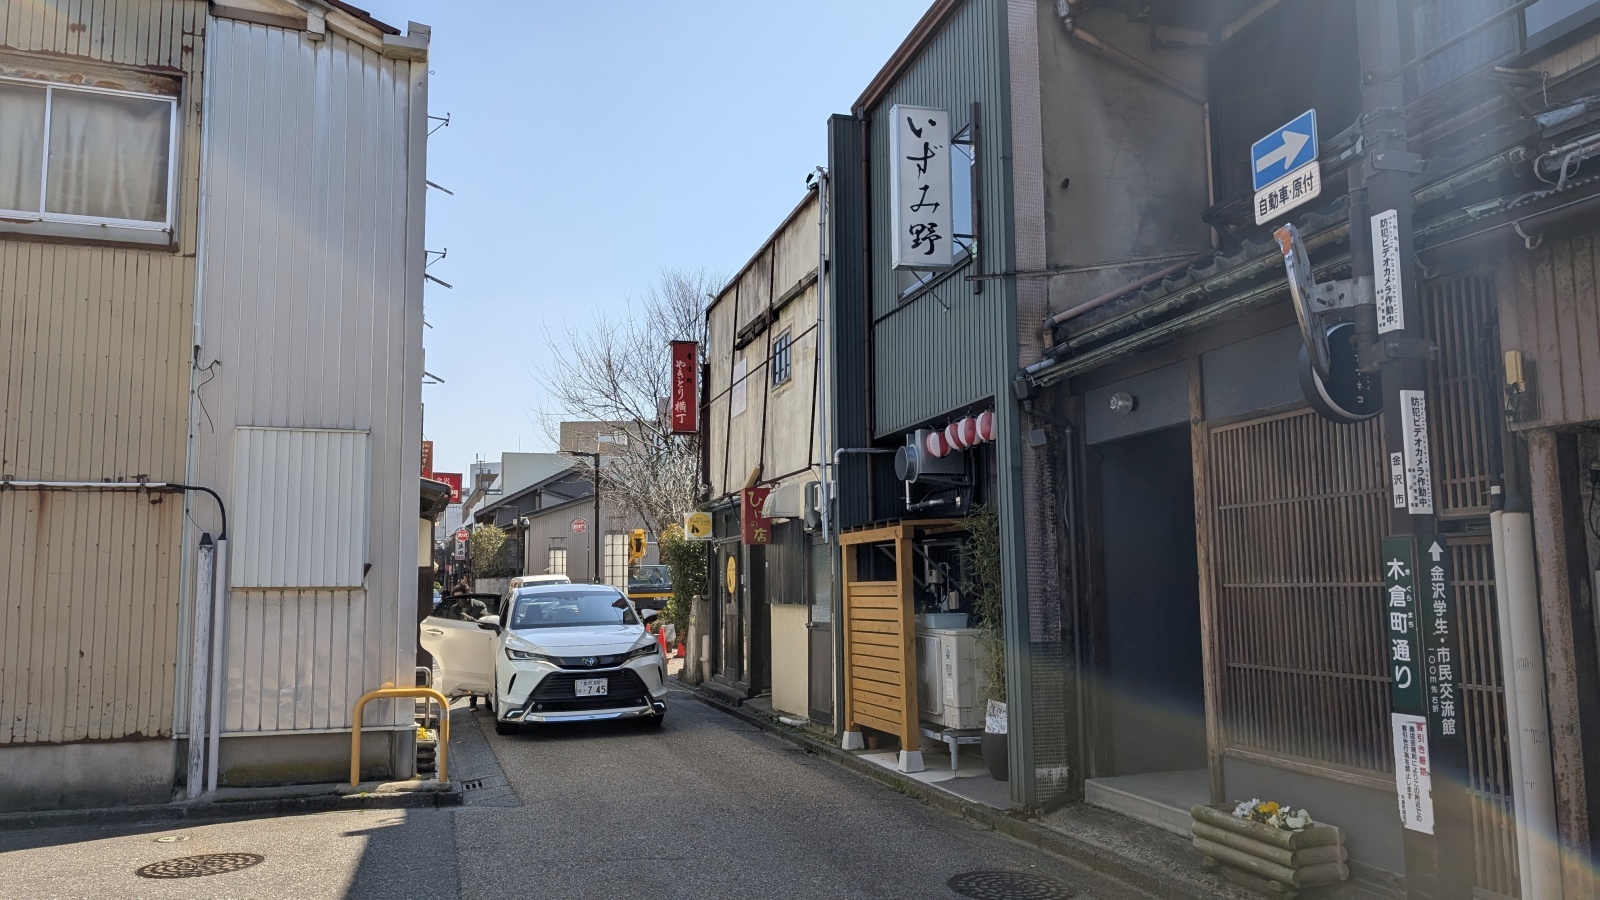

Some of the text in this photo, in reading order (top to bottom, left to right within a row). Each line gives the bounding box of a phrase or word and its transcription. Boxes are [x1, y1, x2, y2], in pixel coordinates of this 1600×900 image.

[907, 116, 943, 255] いずみ野
[1259, 171, 1314, 217] 自動車・原付
[1380, 218, 1394, 325] 防犯ビデオカメラ作動中
[675, 359, 687, 424] やきとり横丁
[1392, 455, 1404, 505] 金沢市
[1411, 396, 1427, 508] 防犯ビデオカメラ作動中
[1387, 557, 1412, 689] 木倉町通り
[1430, 565, 1456, 736] 金沢学生・市民交流館
[1416, 722, 1427, 777] 客引き厳禁
